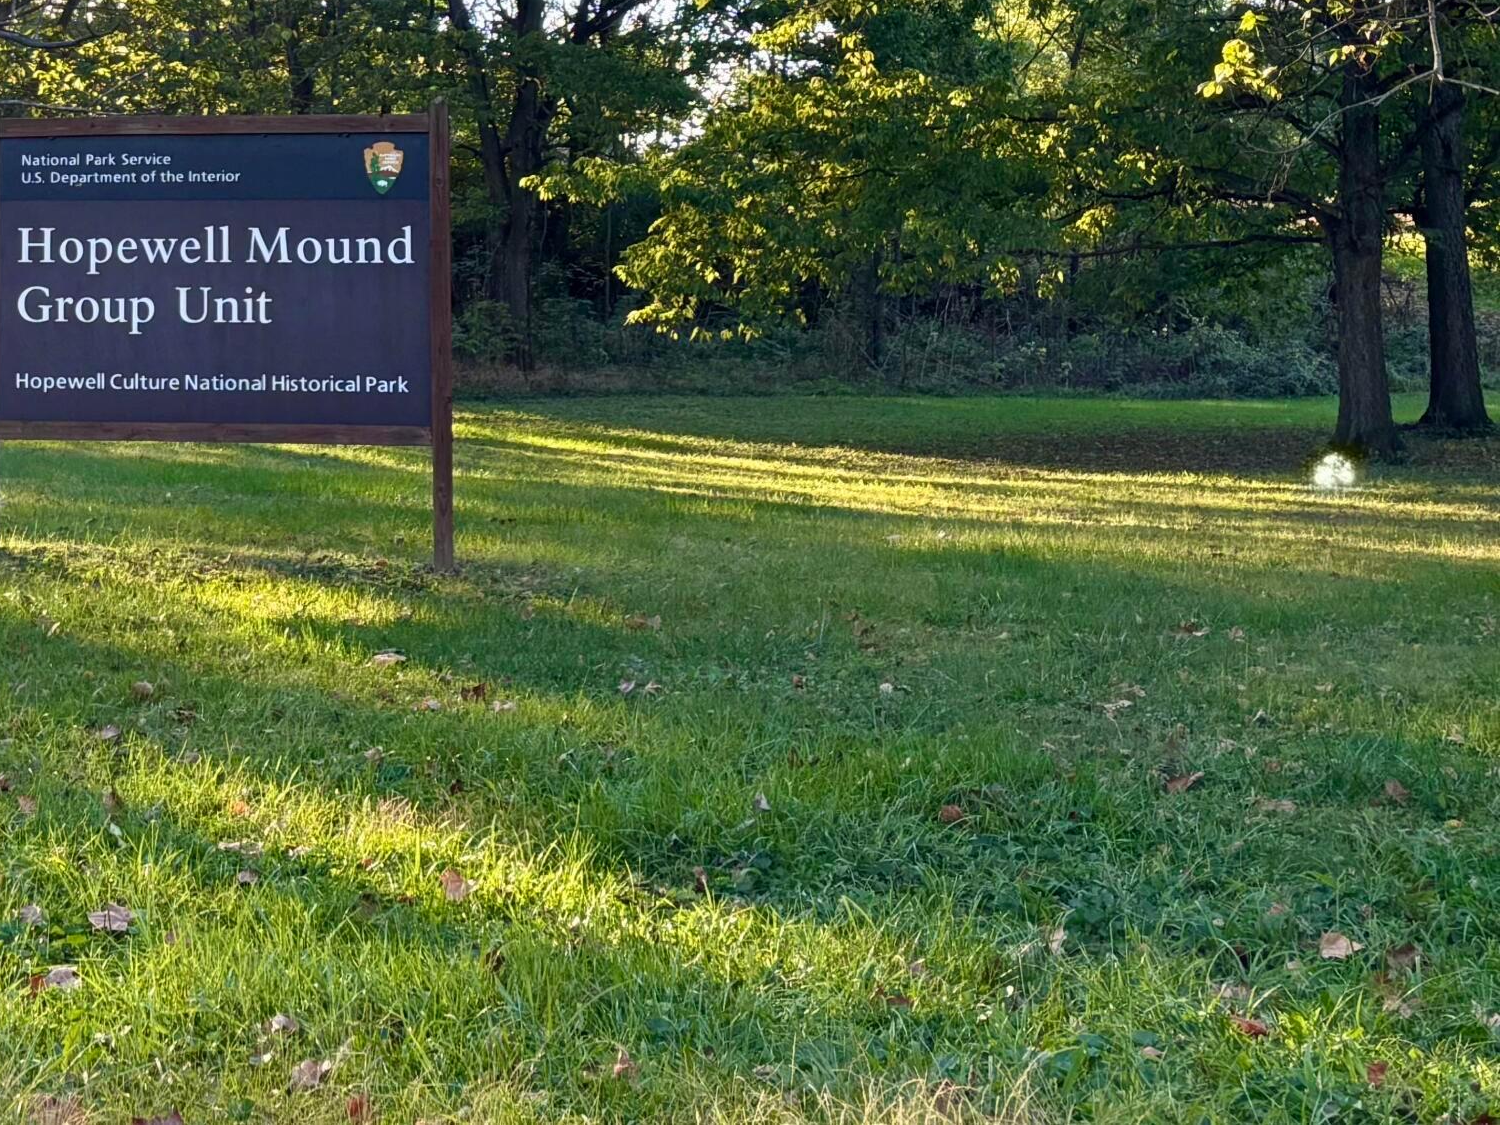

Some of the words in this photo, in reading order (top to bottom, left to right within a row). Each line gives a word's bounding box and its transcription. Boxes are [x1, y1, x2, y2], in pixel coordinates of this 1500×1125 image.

[21, 153, 80, 166] National
[86, 153, 116, 166] Park
[121, 153, 172, 166] Service
[21, 171, 45, 184] U.S.
[50, 171, 137, 186] Department
[141, 170, 157, 183] of
[159, 170, 185, 183] the
[188, 170, 241, 183] Interior
[17, 225, 232, 275] Hopewell
[245, 225, 415, 265] Mound
[16, 285, 155, 335] Group
[174, 286, 273, 324] Unit
[15, 372, 105, 393] Hopewell
[109, 373, 180, 392] Culture
[184, 373, 267, 392] National
[271, 374, 361, 393] Historical
[365, 375, 410, 394] Park
